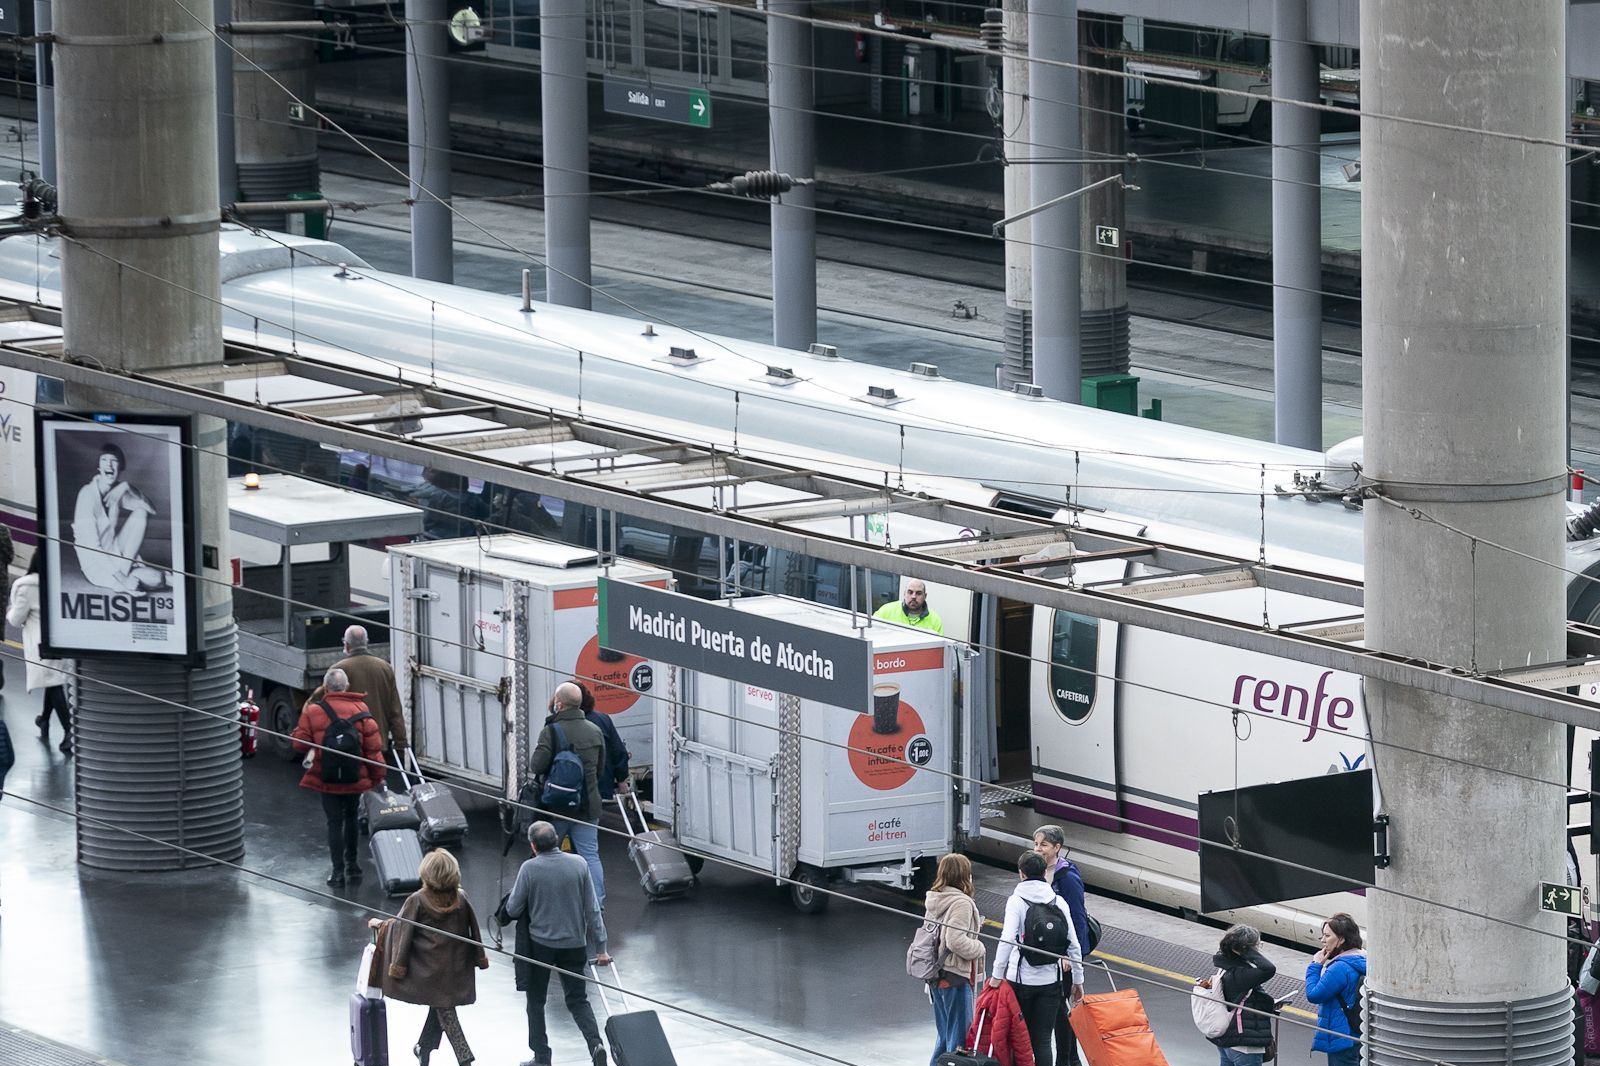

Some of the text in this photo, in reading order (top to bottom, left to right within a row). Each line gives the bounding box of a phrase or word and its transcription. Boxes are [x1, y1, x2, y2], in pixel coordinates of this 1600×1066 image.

[628, 90, 649, 106] Salida
[61, 592, 167, 624] MEISEL
[629, 604, 834, 681] Madrid Puerta de Atocha
[876, 657, 906, 670] bordo
[747, 686, 774, 702] serveo
[1056, 688, 1090, 705] CAFETERIA
[1232, 670, 1354, 742] renfe
[877, 744, 897, 754] café
[868, 817, 901, 831] el café
[868, 831, 907, 842] del tren
